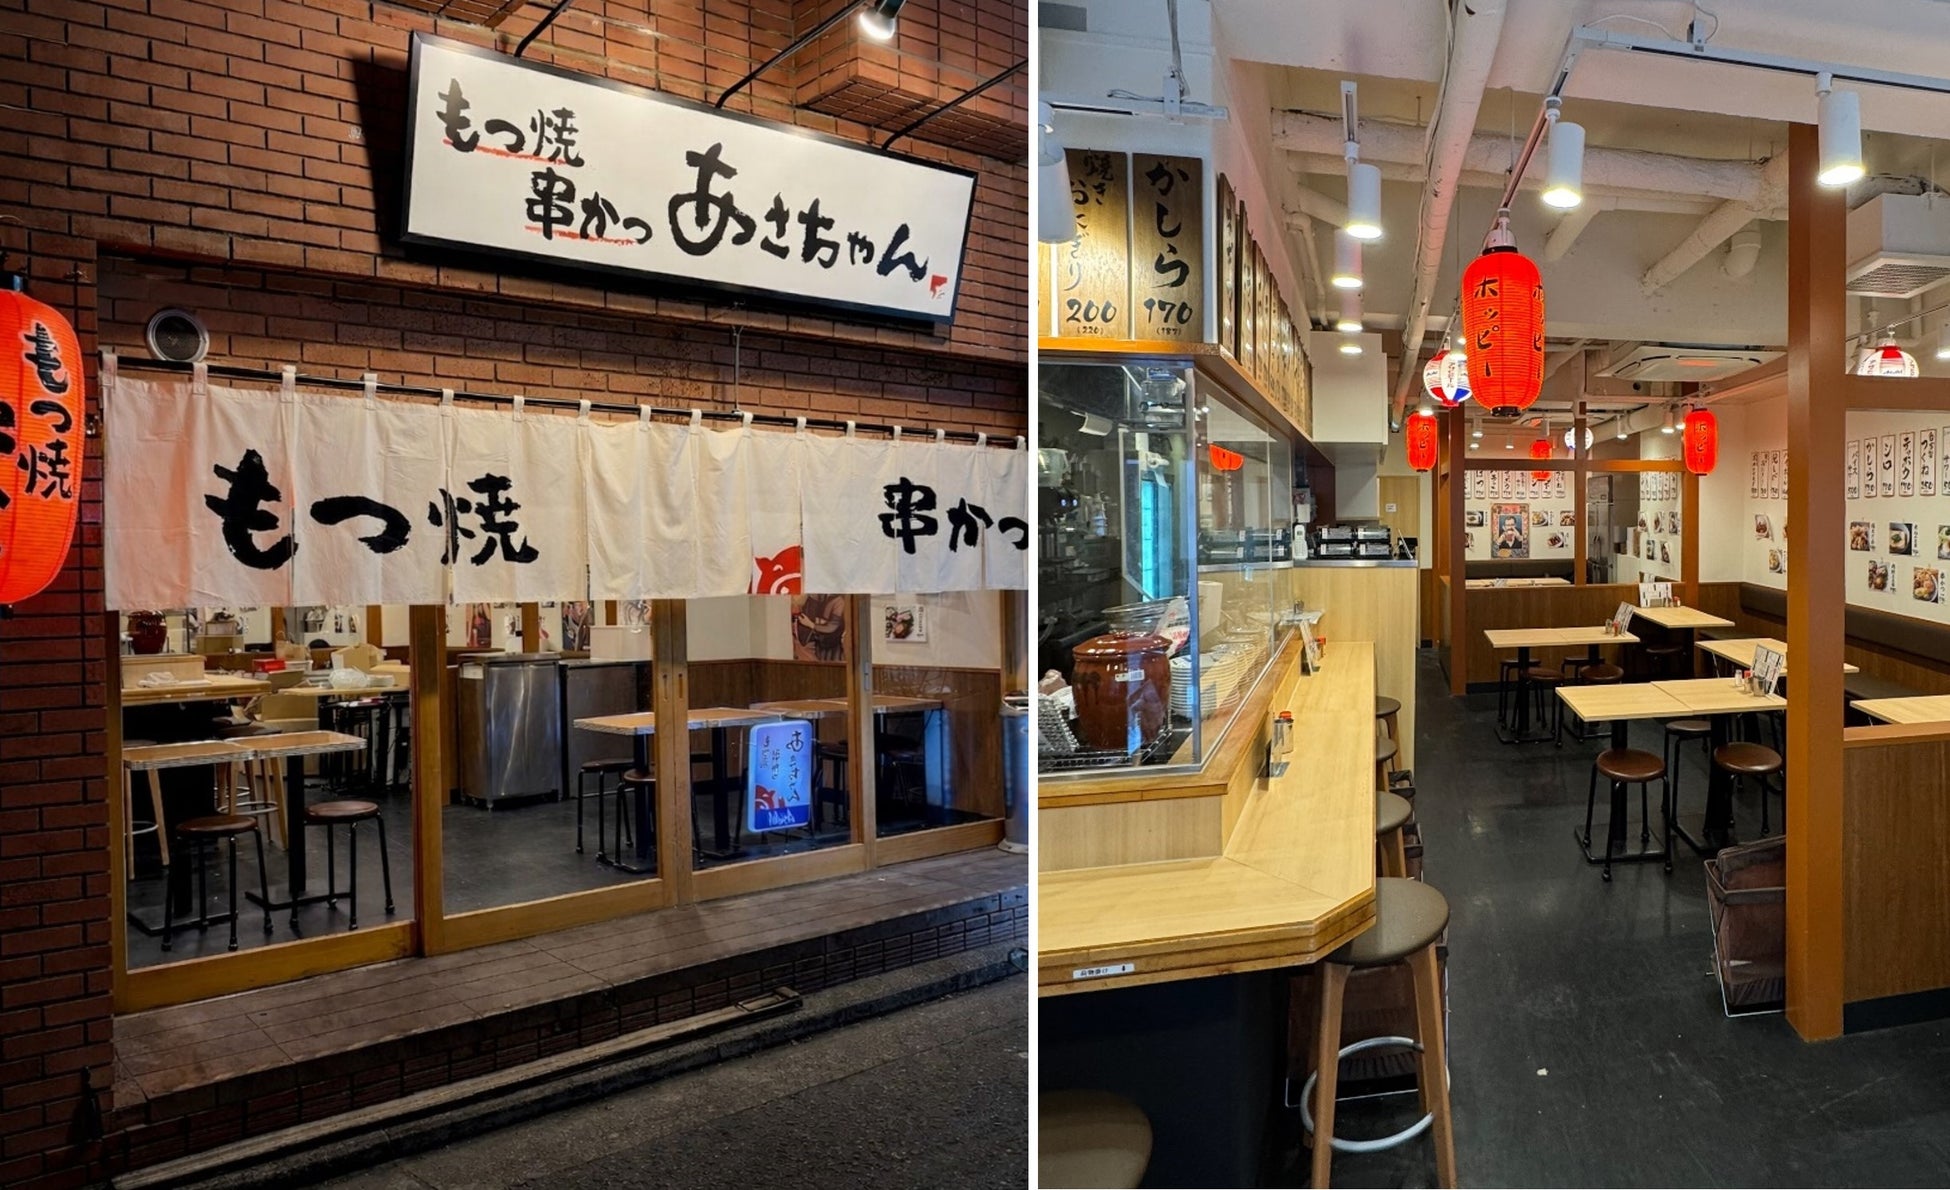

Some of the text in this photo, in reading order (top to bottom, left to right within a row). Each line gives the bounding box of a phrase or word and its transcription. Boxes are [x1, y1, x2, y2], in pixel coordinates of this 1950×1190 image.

[436, 78, 585, 167] もつ焼
[525, 167, 653, 245] 串かつ
[667, 142, 930, 283] あさちゃん
[1083, 153, 1114, 206] 焼き
[1146, 162, 1190, 288] かしら
[1066, 298, 1117, 323] 200
[1077, 326, 1104, 335] (220)
[1143, 297, 1193, 324] 170
[1473, 274, 1500, 378] ホッピー
[17, 322, 74, 499] もつ焼
[1866, 442, 1875, 482] かしら
[204, 448, 1028, 570] もつ焼 串かつ
